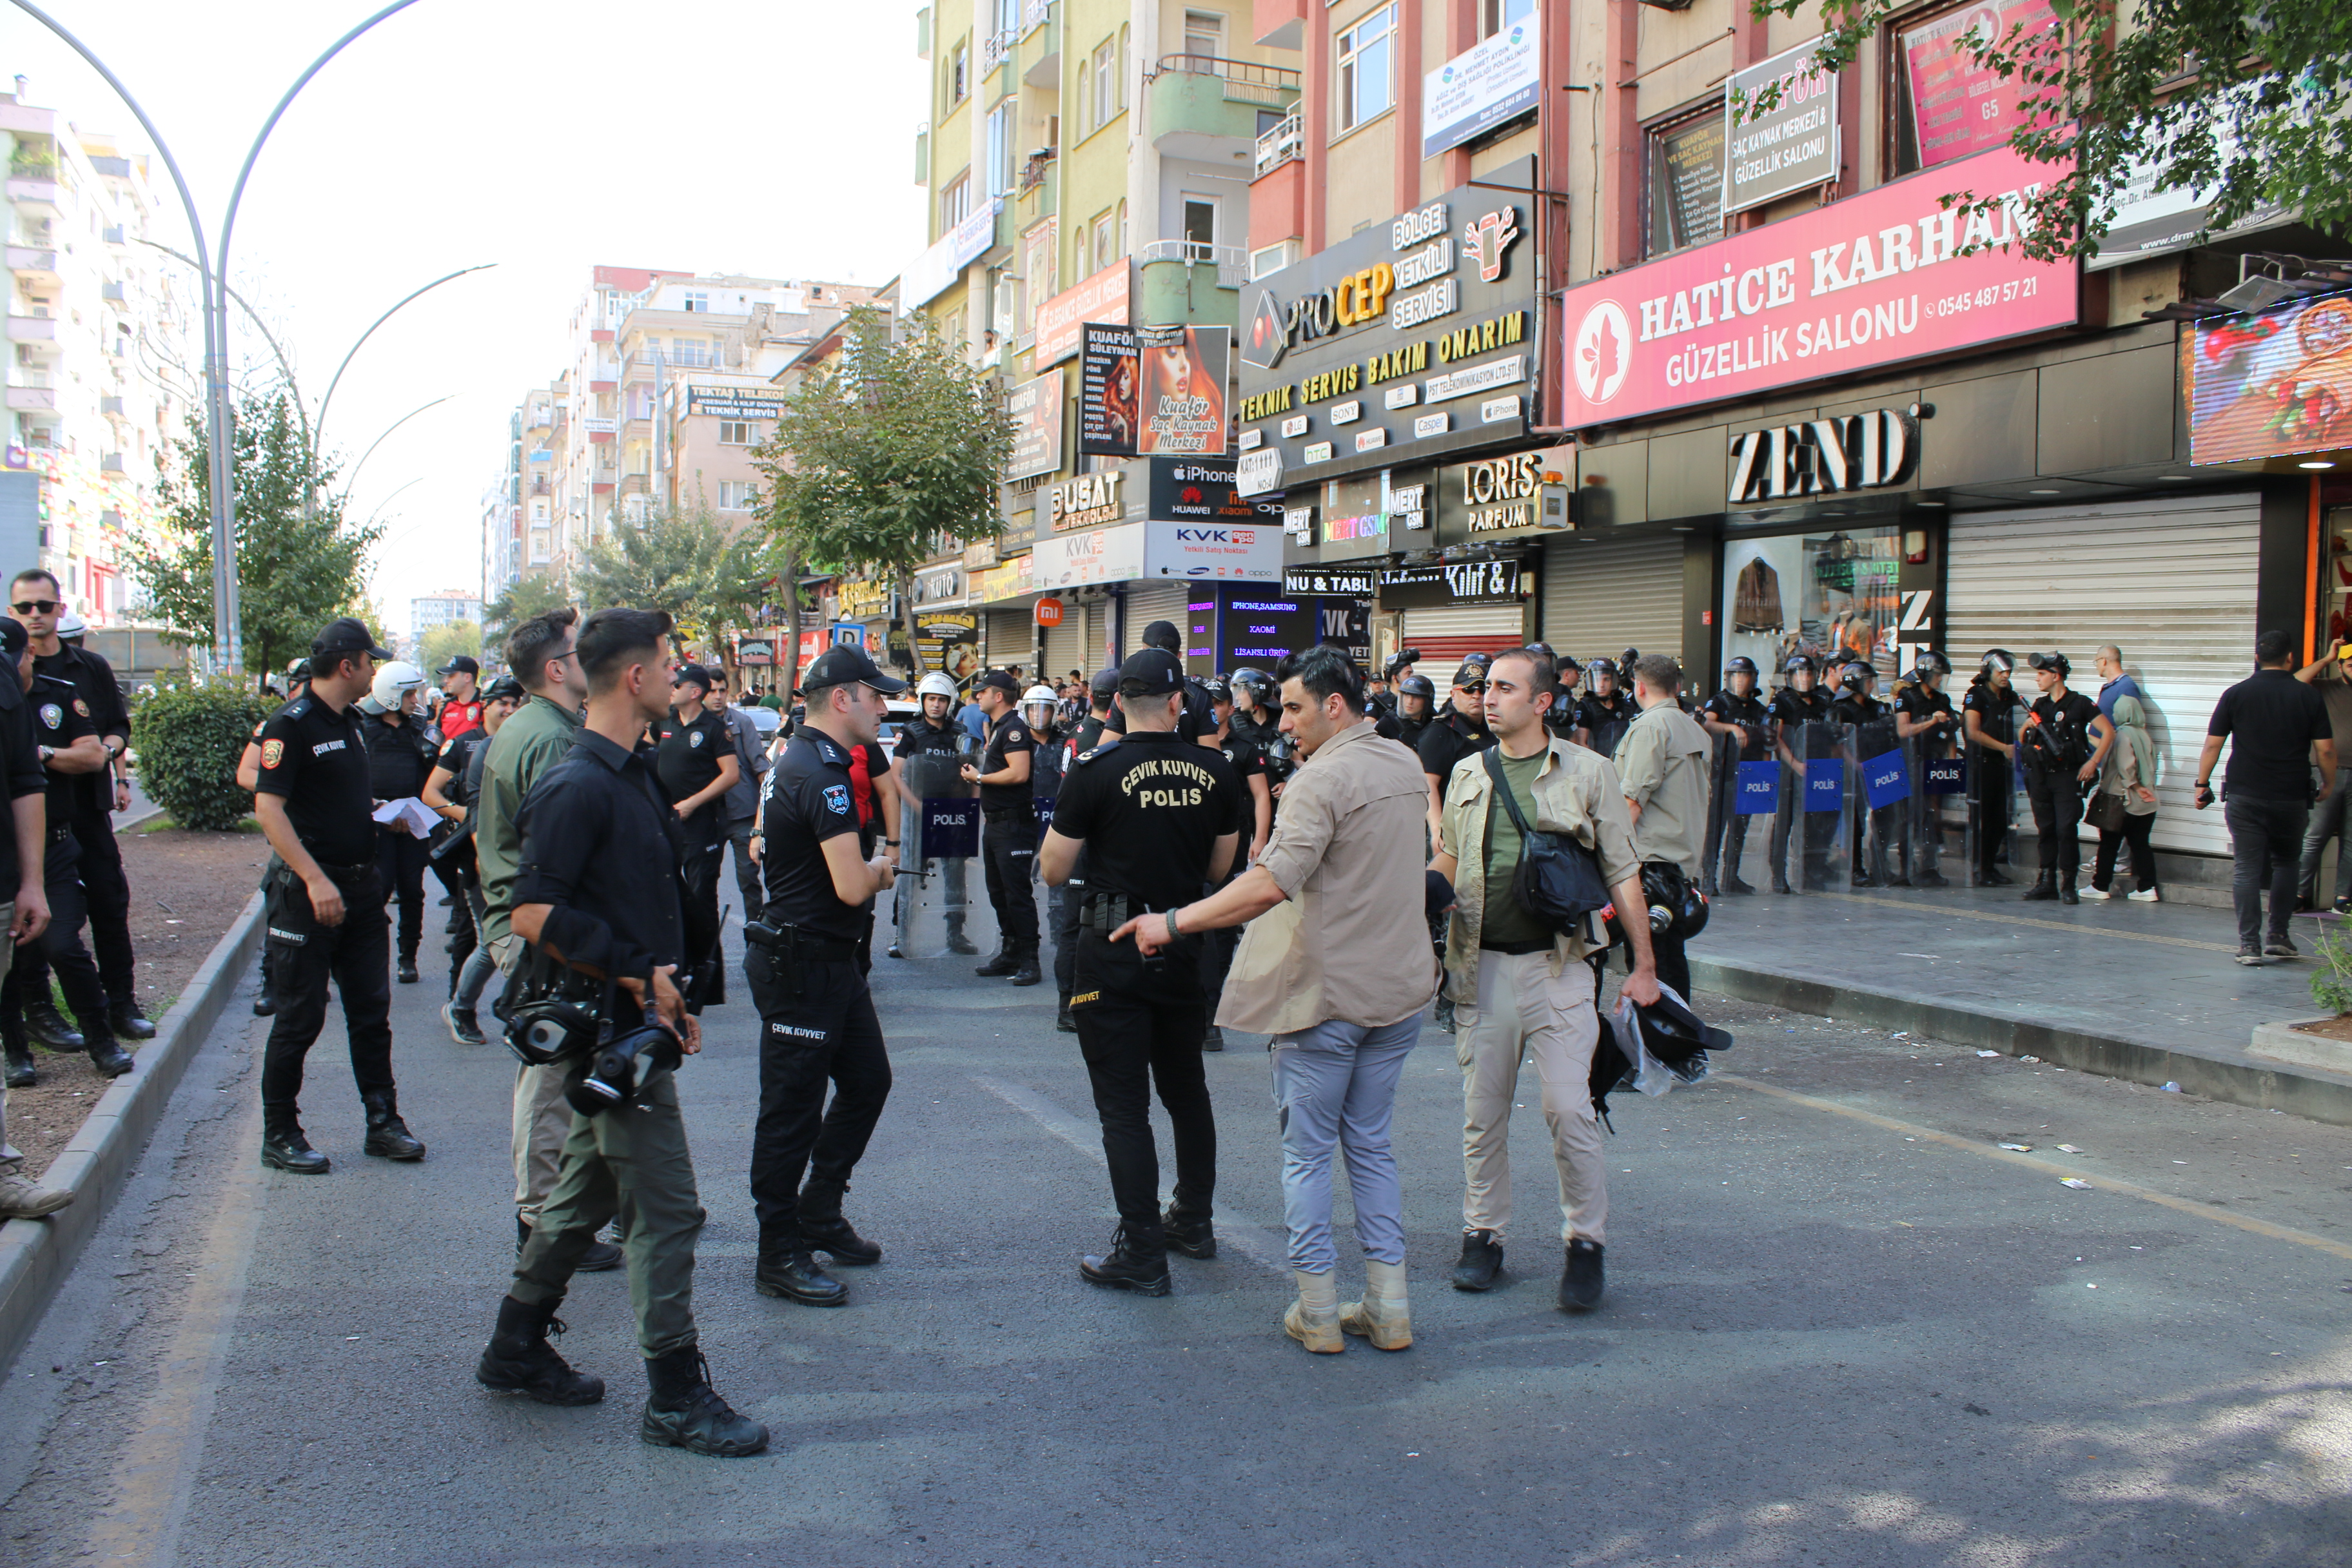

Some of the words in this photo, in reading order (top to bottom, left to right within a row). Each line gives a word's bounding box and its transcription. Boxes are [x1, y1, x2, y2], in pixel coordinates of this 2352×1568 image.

[1465, 55, 1489, 75] MEHMET
[1491, 44, 1509, 61] AYDIN
[1474, 46, 1489, 60] ÖZEL
[1493, 43, 1530, 71] POLİKLİNİĞİ
[1981, 99, 1999, 120] G5
[1679, 130, 1709, 150] KUAFÖR
[1732, 138, 1747, 159] SAÇ
[1749, 124, 1781, 153] KAYNAK
[1783, 106, 1818, 141] MERKEZİ
[1820, 106, 1826, 125] &
[1667, 153, 1678, 164] VE
[1678, 148, 1692, 161] SAÇ
[1692, 134, 1725, 153] KAYNAK
[1682, 147, 1713, 169] MERKEZİ
[1735, 151, 1781, 184] GÜZELLİK
[1783, 135, 1825, 168] SALONU
[1393, 203, 1444, 251] BÖLGE
[1393, 238, 1452, 290] YETKİLİ
[1640, 263, 1796, 342] HATİCE
[1810, 183, 2041, 297] KARHAN
[1284, 262, 1393, 348] PROCEP
[1157, 328, 1183, 339] dövme
[1665, 325, 1789, 387] GÜZELLİK
[1796, 295, 1919, 358] SALONU
[1938, 292, 1970, 318] 0545
[1974, 286, 1999, 311] 487
[2003, 282, 2021, 306] 57
[2023, 277, 2037, 299] 21
[1090, 344, 1137, 357] SÜLEYMAN
[1367, 340, 1427, 385] BAKIM
[1438, 310, 1523, 363] ONARIM
[1086, 356, 1111, 365] BREZİLYA
[692, 387, 735, 399] TEKTAŞ
[1428, 382, 1438, 397] PST
[757, 400, 785, 409] DÜNYASI
[1010, 386, 1036, 413] KUAFÖR
[1159, 395, 1210, 418] Kuaför
[704, 405, 741, 416] TEKNİK
[742, 406, 777, 418] SERVİS
[1084, 413, 1104, 422] POSTİŞ
[1333, 406, 1356, 420] SONY
[1493, 403, 1517, 415] iPhone
[1150, 416, 1170, 435] Saç
[1172, 417, 1218, 436] Kaynak
[1294, 420, 1302, 431] LG
[1418, 416, 1444, 432] Casper
[1084, 431, 1112, 440] ÇEŞİTLERİ
[1159, 433, 1208, 450] Merkezi
[1240, 433, 1259, 446] SAMSUNG
[1366, 435, 1382, 445] HUAWEI
[1729, 409, 1910, 504] ZEND
[1188, 465, 1236, 482] iPhone
[1464, 454, 1535, 505] LORIS
[1257, 479, 1272, 490] NO:4
[1051, 471, 1119, 520] PUSAT
[1390, 484, 1424, 516] MERT
[1172, 505, 1210, 515] HUAWEI
[1469, 504, 1528, 533] PARFUM
[1284, 507, 1311, 534] MERT
[1324, 518, 1357, 542] MERT
[1359, 513, 1386, 537] GSM
[1406, 509, 1424, 529] GSM
[1177, 529, 1228, 542] KVK
[1297, 529, 1311, 546] GSM
[1066, 534, 1091, 557] KVK
[1206, 546, 1222, 554] Satış
[1314, 576, 1328, 591] &
[1489, 562, 1505, 594] &
[1233, 602, 1297, 611] IPHONE,SAMSUNG
[1250, 625, 1275, 634] XAOMİ
[1235, 647, 1267, 656] LİSANSLI
[1269, 647, 1289, 656] ÜRÜN
[1161, 760, 1216, 792] KUVVET
[1875, 770, 1899, 787] POLİS
[1930, 769, 1959, 779] POLİS
[1747, 781, 1770, 792] POLİS
[1814, 778, 1834, 790] POLİS
[281, 930, 305, 943] KUVVET
[1077, 990, 1100, 1004] KUVVET
[794, 1026, 826, 1042] KUVVET
